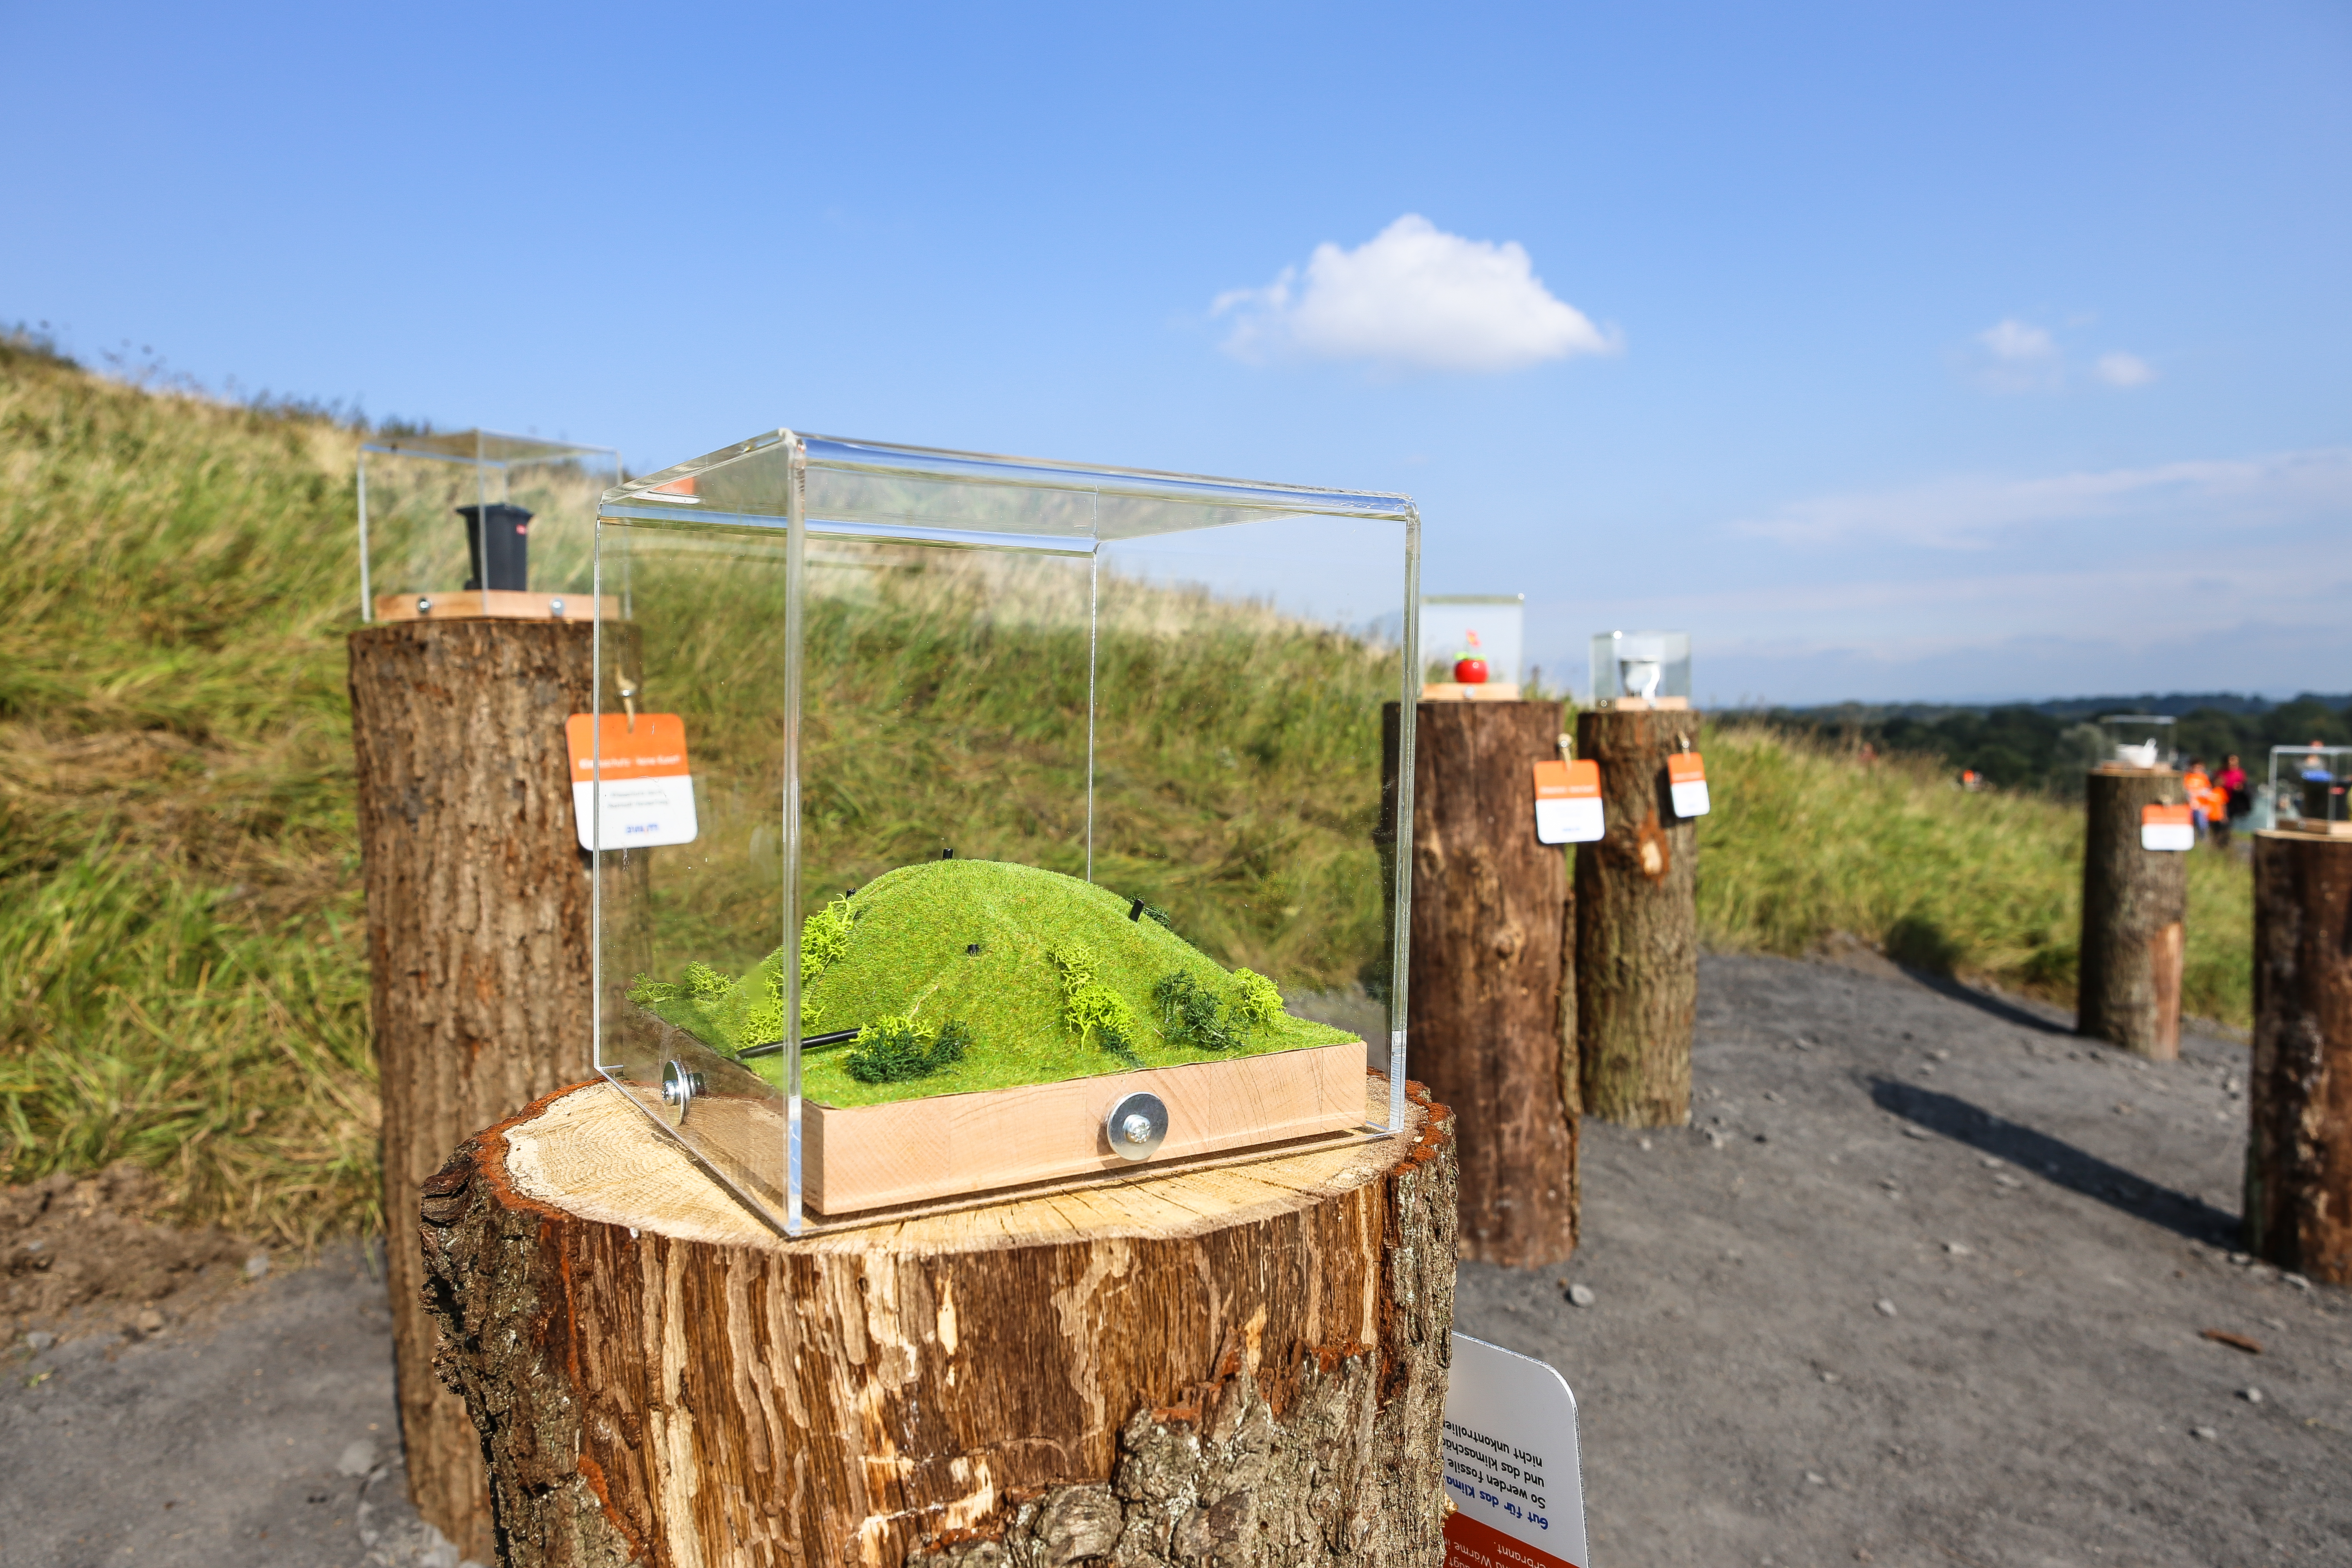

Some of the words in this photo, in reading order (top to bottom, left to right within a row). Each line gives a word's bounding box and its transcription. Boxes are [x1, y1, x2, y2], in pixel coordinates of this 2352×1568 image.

[1513, 1448, 1542, 1467] nicht
[1447, 1458, 1484, 1483] fossile
[1501, 1462, 1520, 1479] das
[1524, 1471, 1545, 1488] und
[1486, 1474, 1528, 1500] werden
[1479, 1491, 1499, 1508] das
[1531, 1494, 1546, 1509] So
[1504, 1502, 1522, 1519] für
[1527, 1511, 1548, 1530] Gut
[1454, 1542, 1492, 1568] Wärme
[1494, 1542, 1549, 1568] erbrannt.
